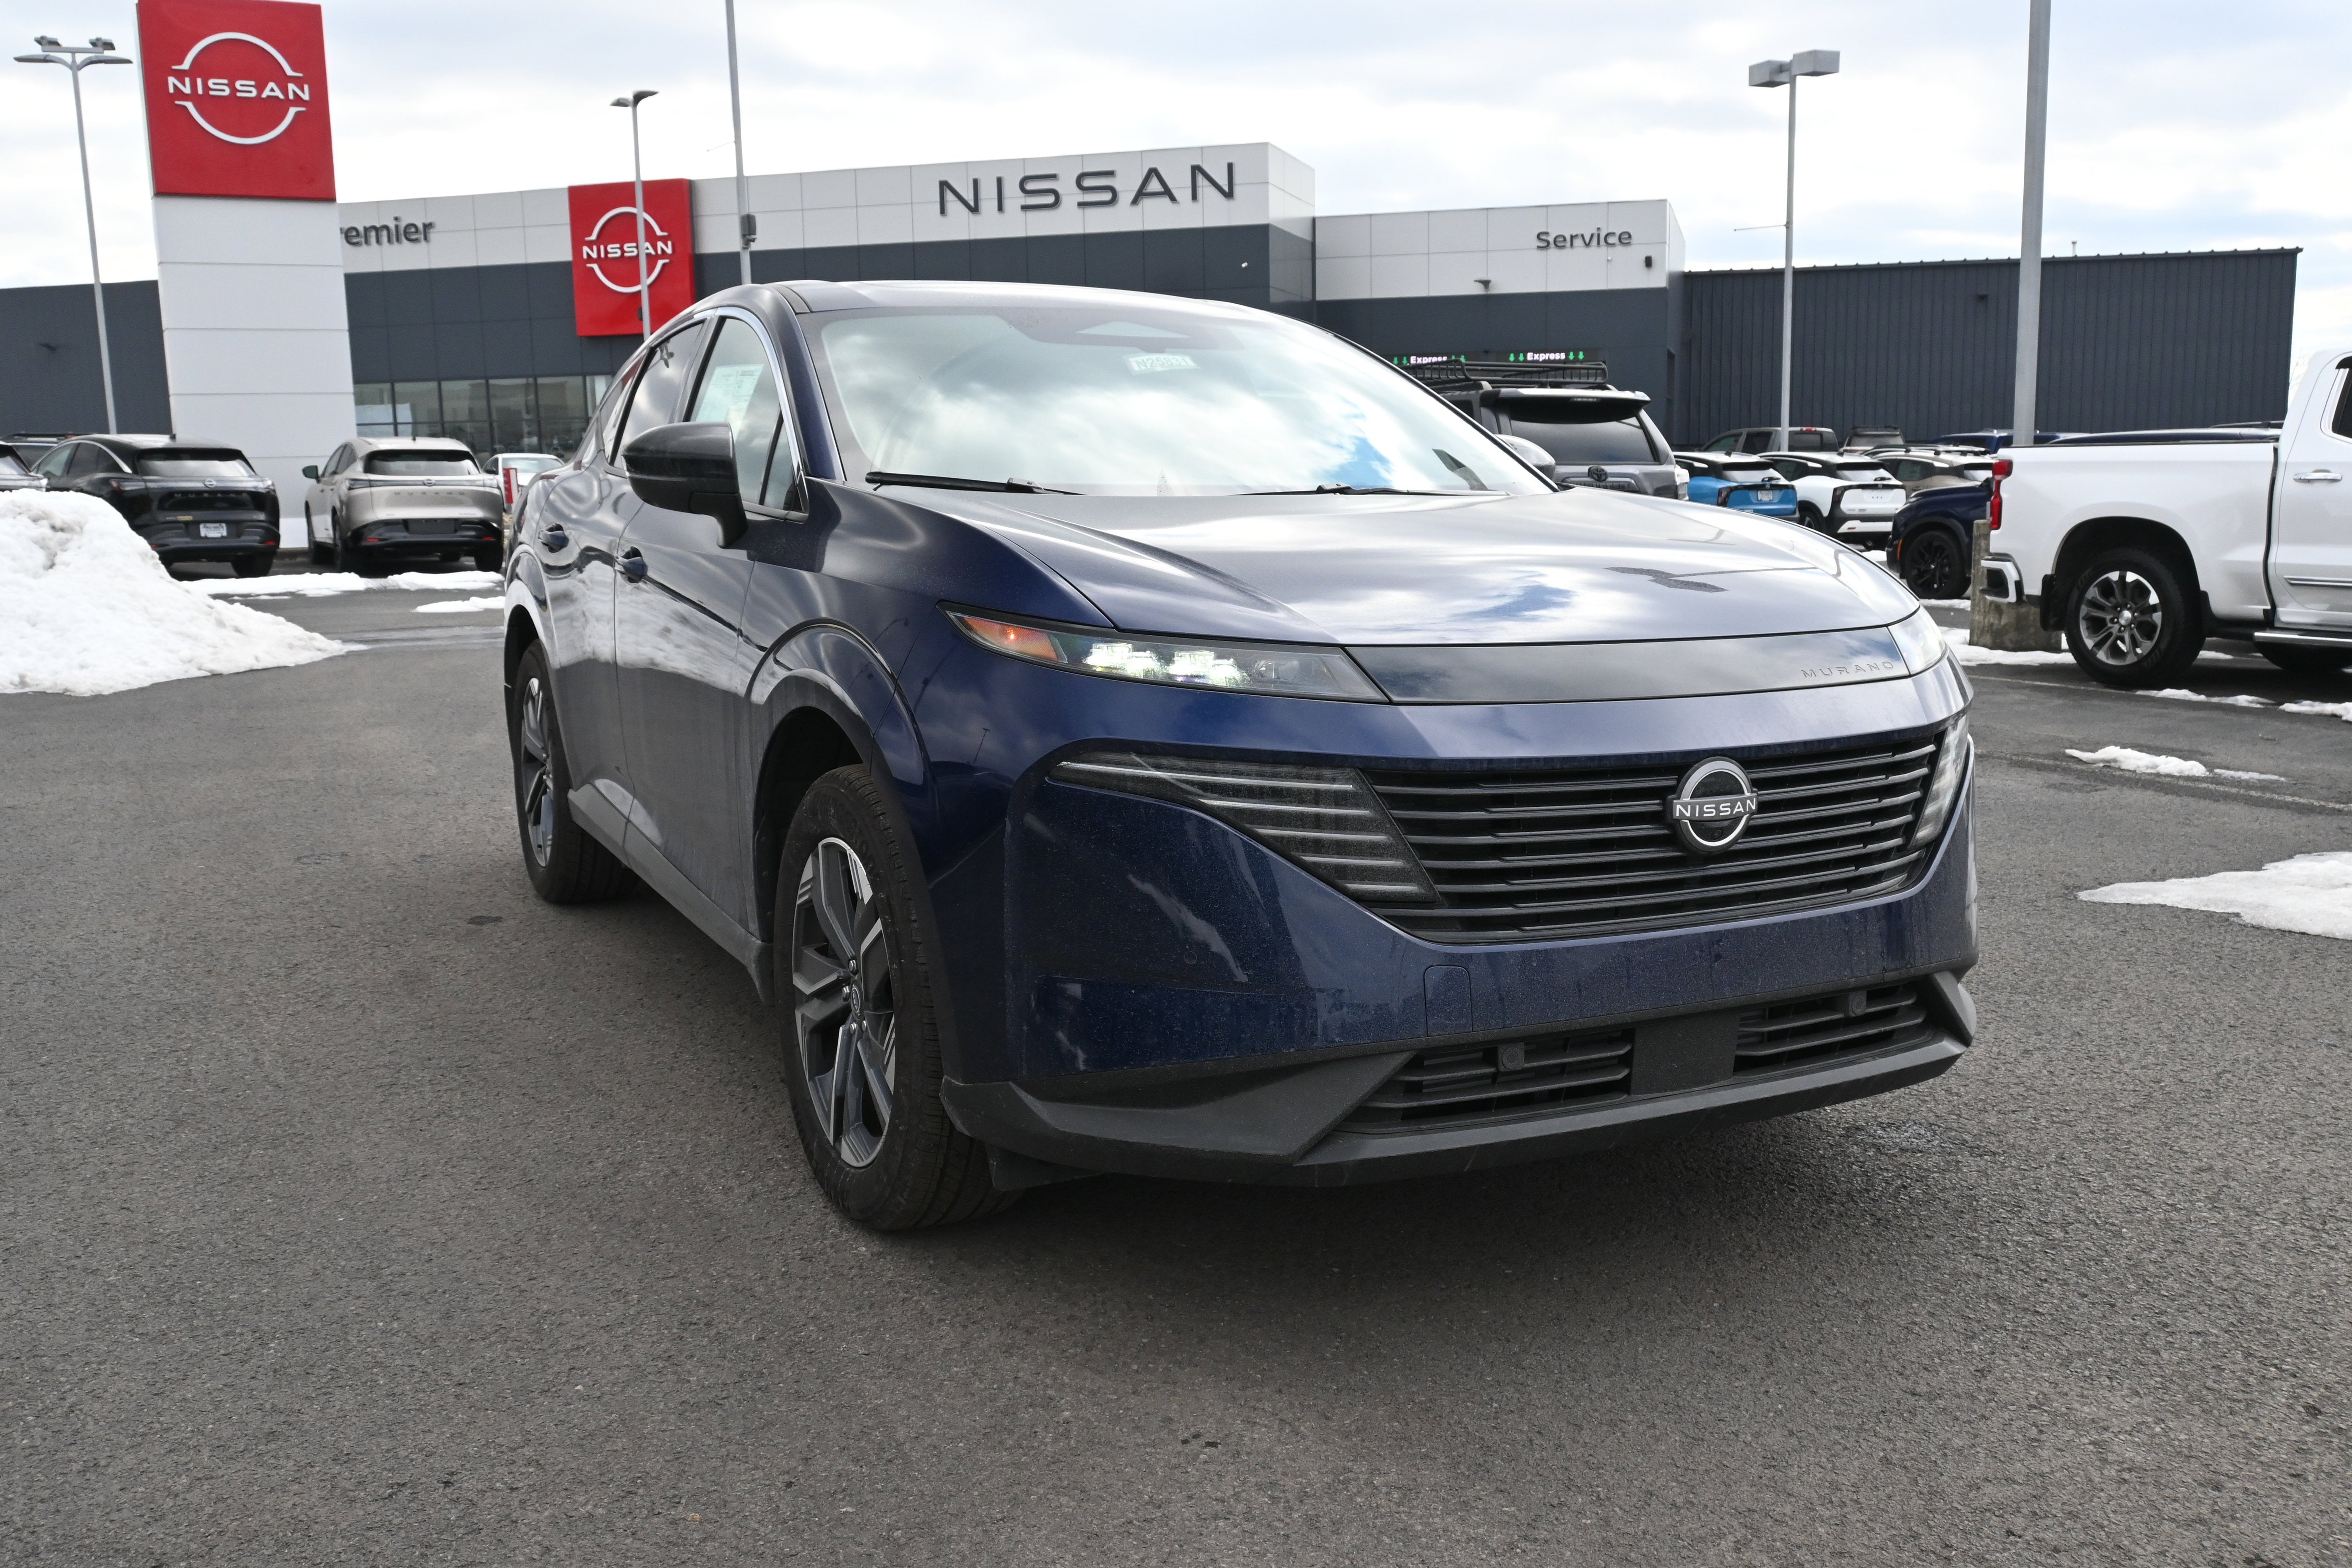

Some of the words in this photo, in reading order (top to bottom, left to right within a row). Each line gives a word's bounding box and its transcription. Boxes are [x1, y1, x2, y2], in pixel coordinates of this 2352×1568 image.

[168, 76, 310, 101] NISSAN
[938, 161, 1235, 215] NISSAN
[340, 216, 435, 246] emier
[1536, 227, 1633, 250] Service
[582, 240, 672, 259] NISSAN
[1527, 352, 1566, 362] Express
[1801, 661, 1894, 678] MURANO
[1676, 798, 1756, 817] NISSAN
